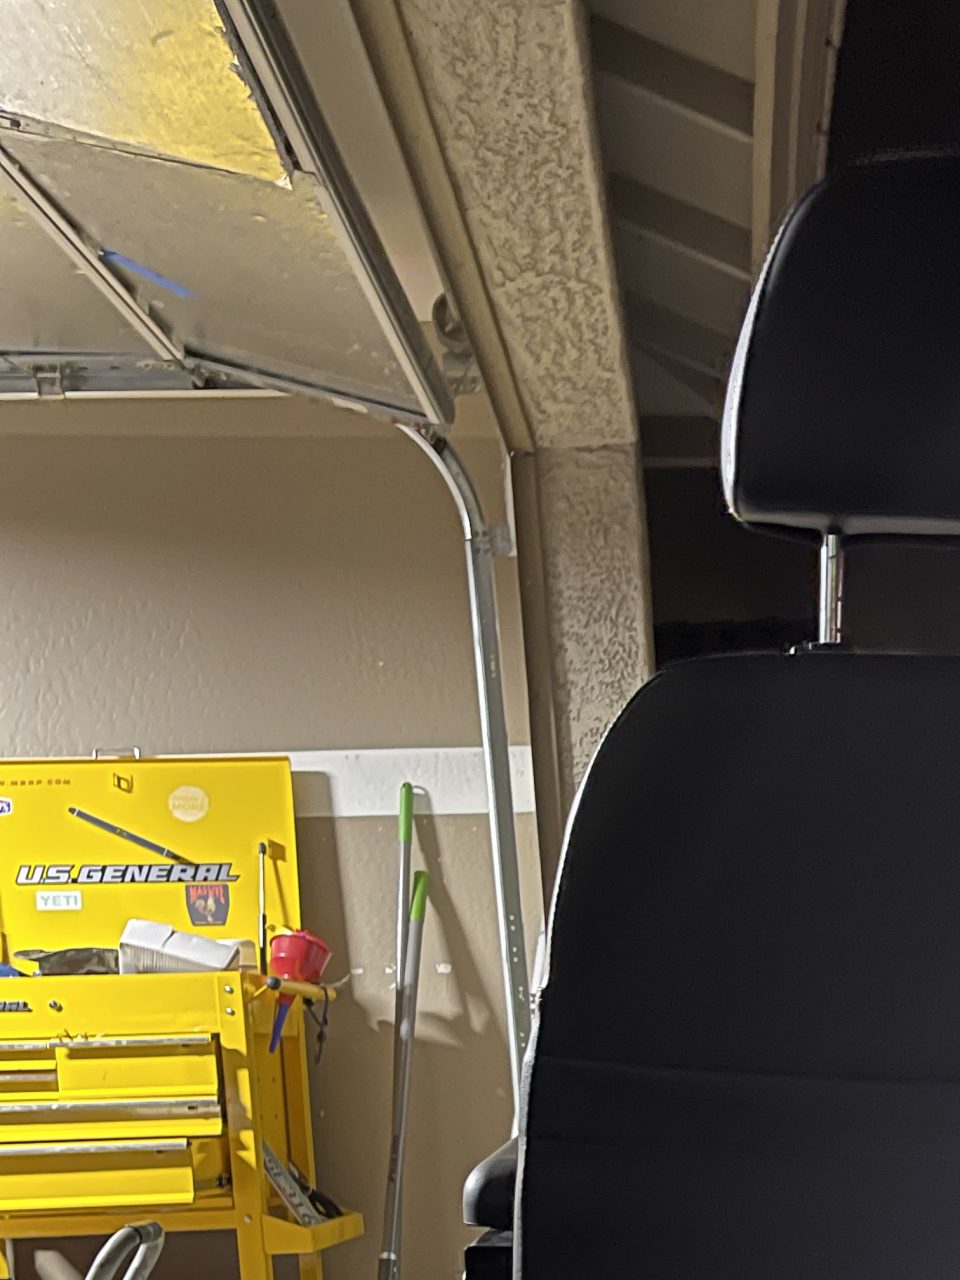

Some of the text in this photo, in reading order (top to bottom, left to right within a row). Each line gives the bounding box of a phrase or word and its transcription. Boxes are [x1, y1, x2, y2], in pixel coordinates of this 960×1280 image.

[16, 863, 240, 885] U.S. GENERAL
[40, 895, 78, 907] YETI
